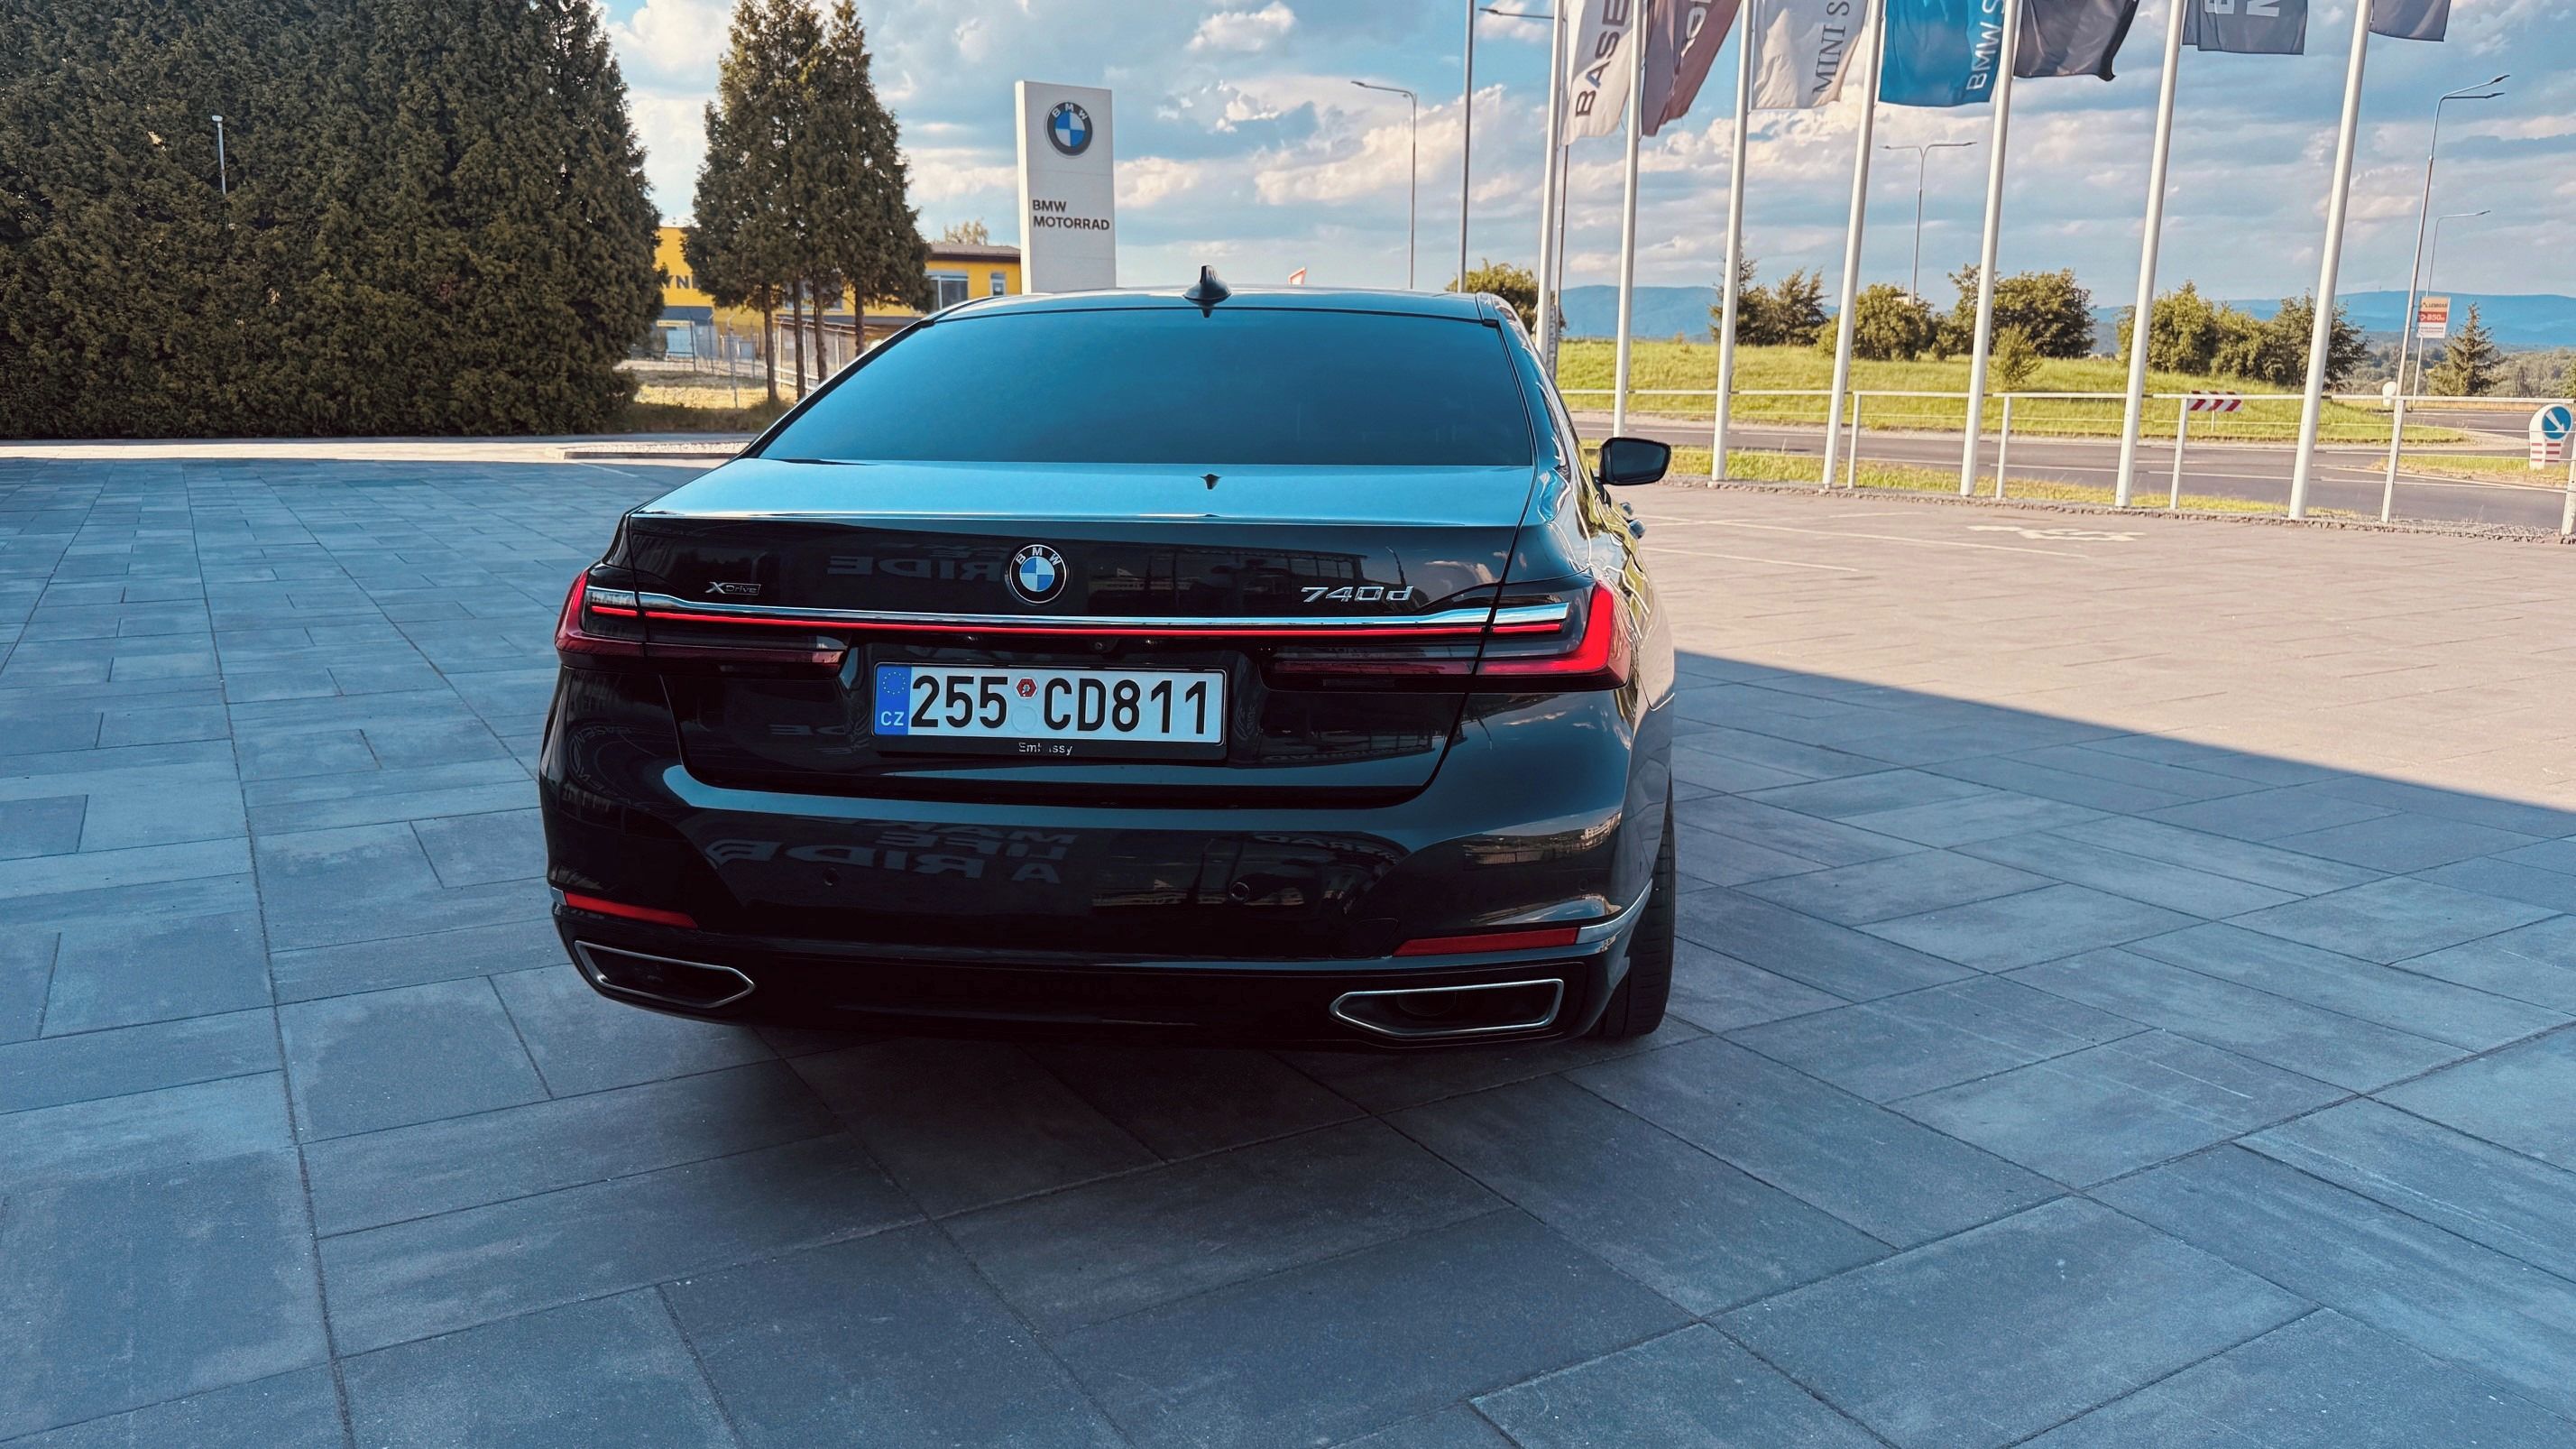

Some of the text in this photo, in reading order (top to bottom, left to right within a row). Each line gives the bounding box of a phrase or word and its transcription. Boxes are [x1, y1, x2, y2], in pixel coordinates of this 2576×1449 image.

[1812, 24, 1845, 95] MINI
[1965, 22, 2002, 90] BMW
[1052, 103, 1088, 121] BMW
[1033, 199, 1067, 213] BMW
[1033, 216, 1110, 230] MOTORRAD
[1015, 547, 1062, 566] BMW
[1301, 586, 1414, 603] 740d
[910, 675, 1008, 729] 255
[1044, 678, 1208, 734] CD811
[880, 711, 905, 726] CZ
